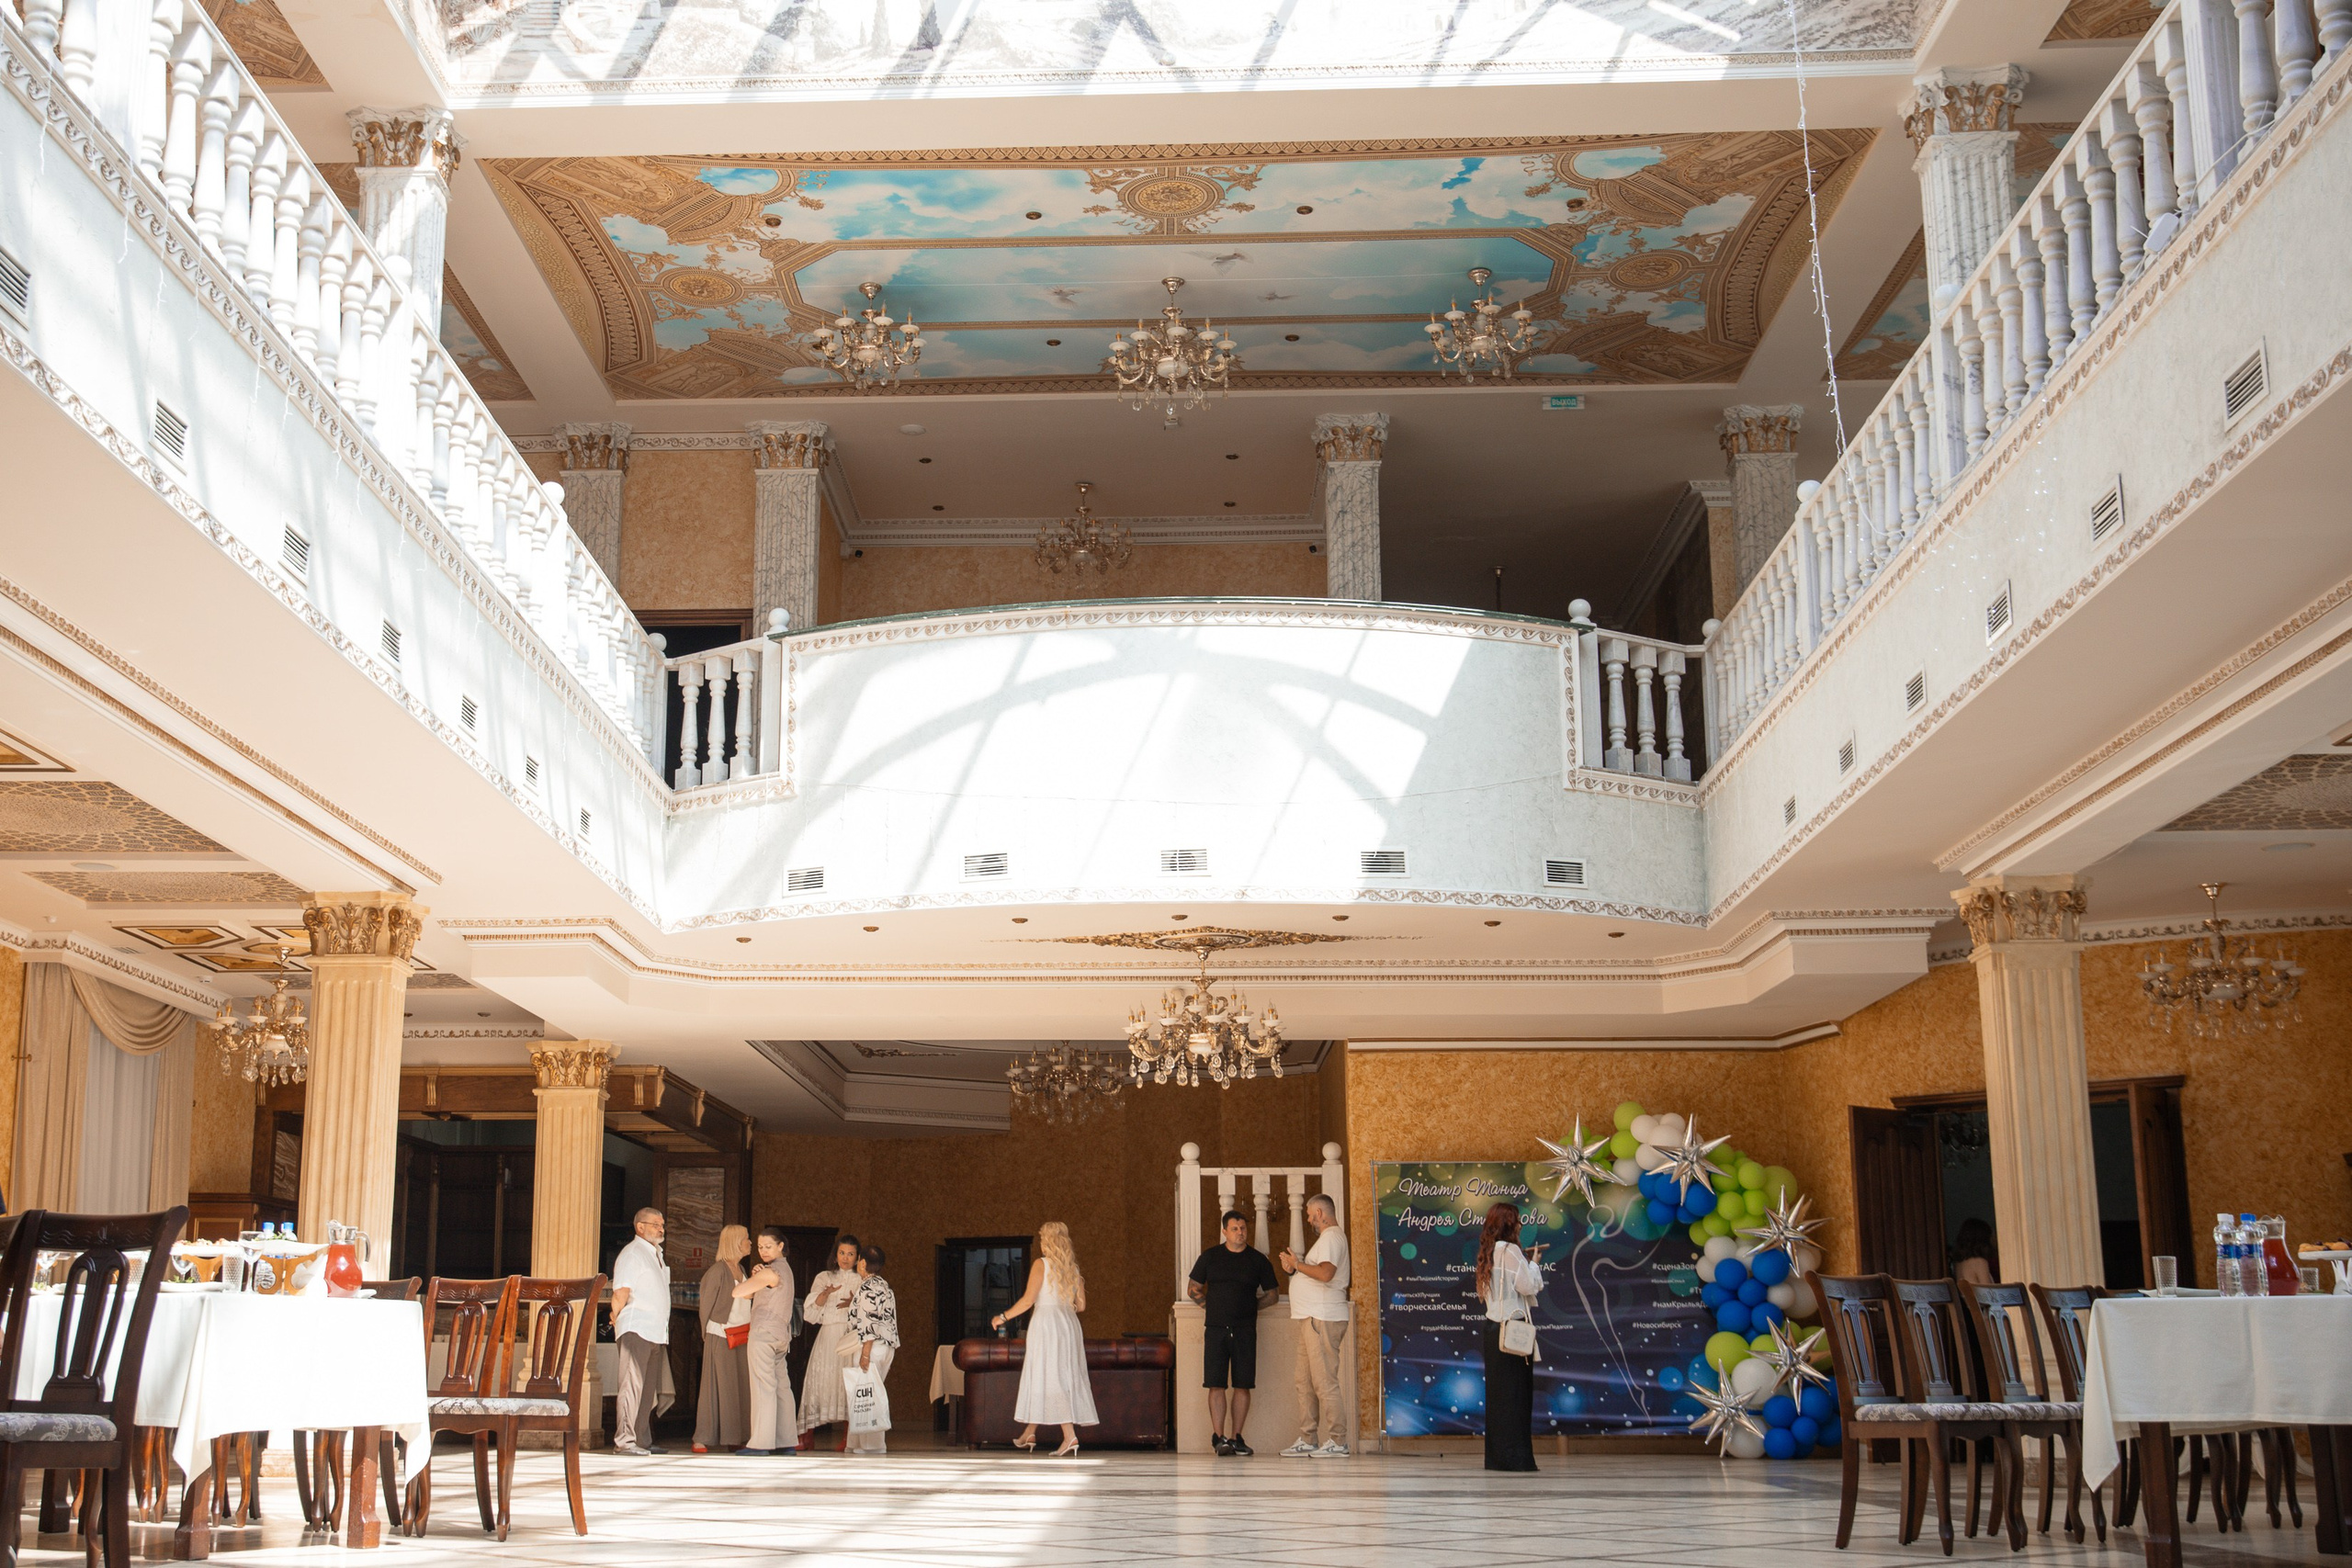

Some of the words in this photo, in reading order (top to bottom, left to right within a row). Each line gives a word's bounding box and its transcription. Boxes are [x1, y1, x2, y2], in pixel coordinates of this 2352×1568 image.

[1552, 398, 1577, 406] ВЫХОД
[1398, 1178, 1462, 1201] Театр
[1466, 1177, 1529, 1198] Танца
[1397, 1207, 1454, 1231] Андрея
[1389, 1302, 1467, 1313] #творческаяСемья
[1632, 1321, 1682, 1329] #Новосибирск
